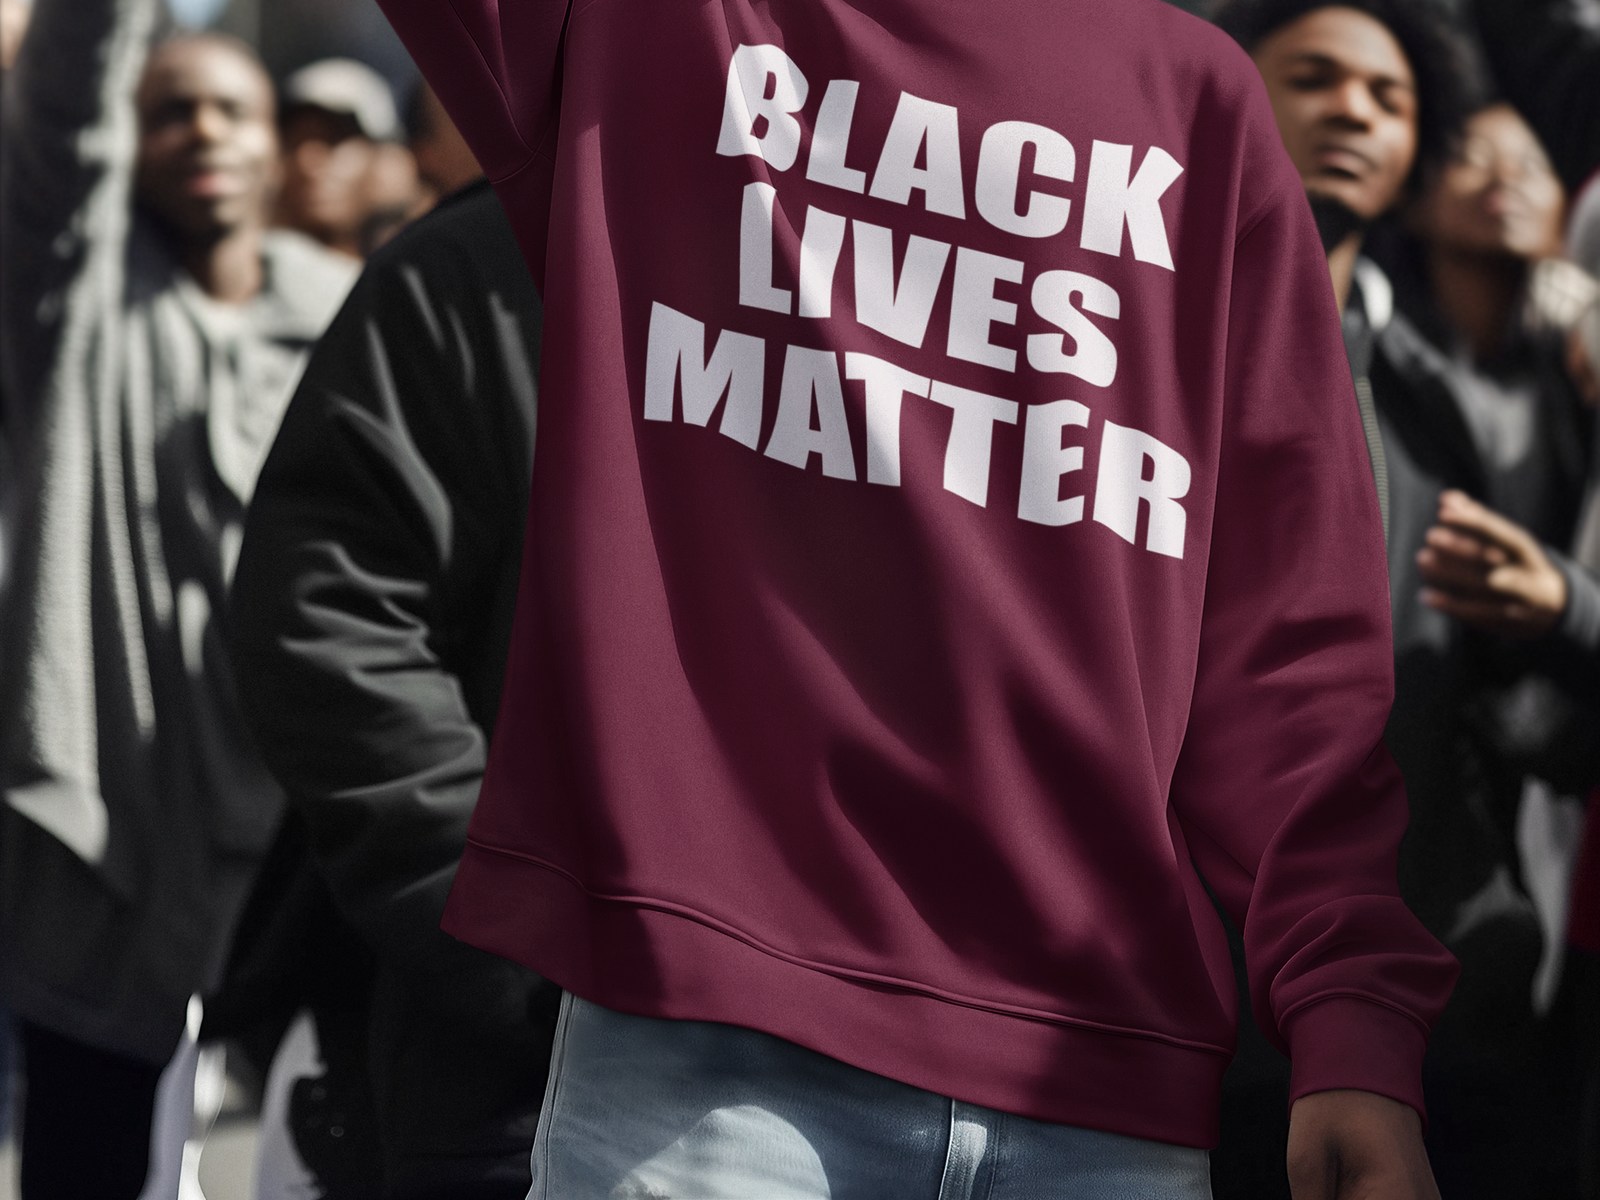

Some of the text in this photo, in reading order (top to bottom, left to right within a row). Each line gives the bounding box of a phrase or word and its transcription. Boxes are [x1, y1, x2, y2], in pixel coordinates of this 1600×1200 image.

[716, 43, 1185, 272] BLACK
[739, 181, 1121, 388] LIVES
[644, 300, 1192, 560] MATTER
